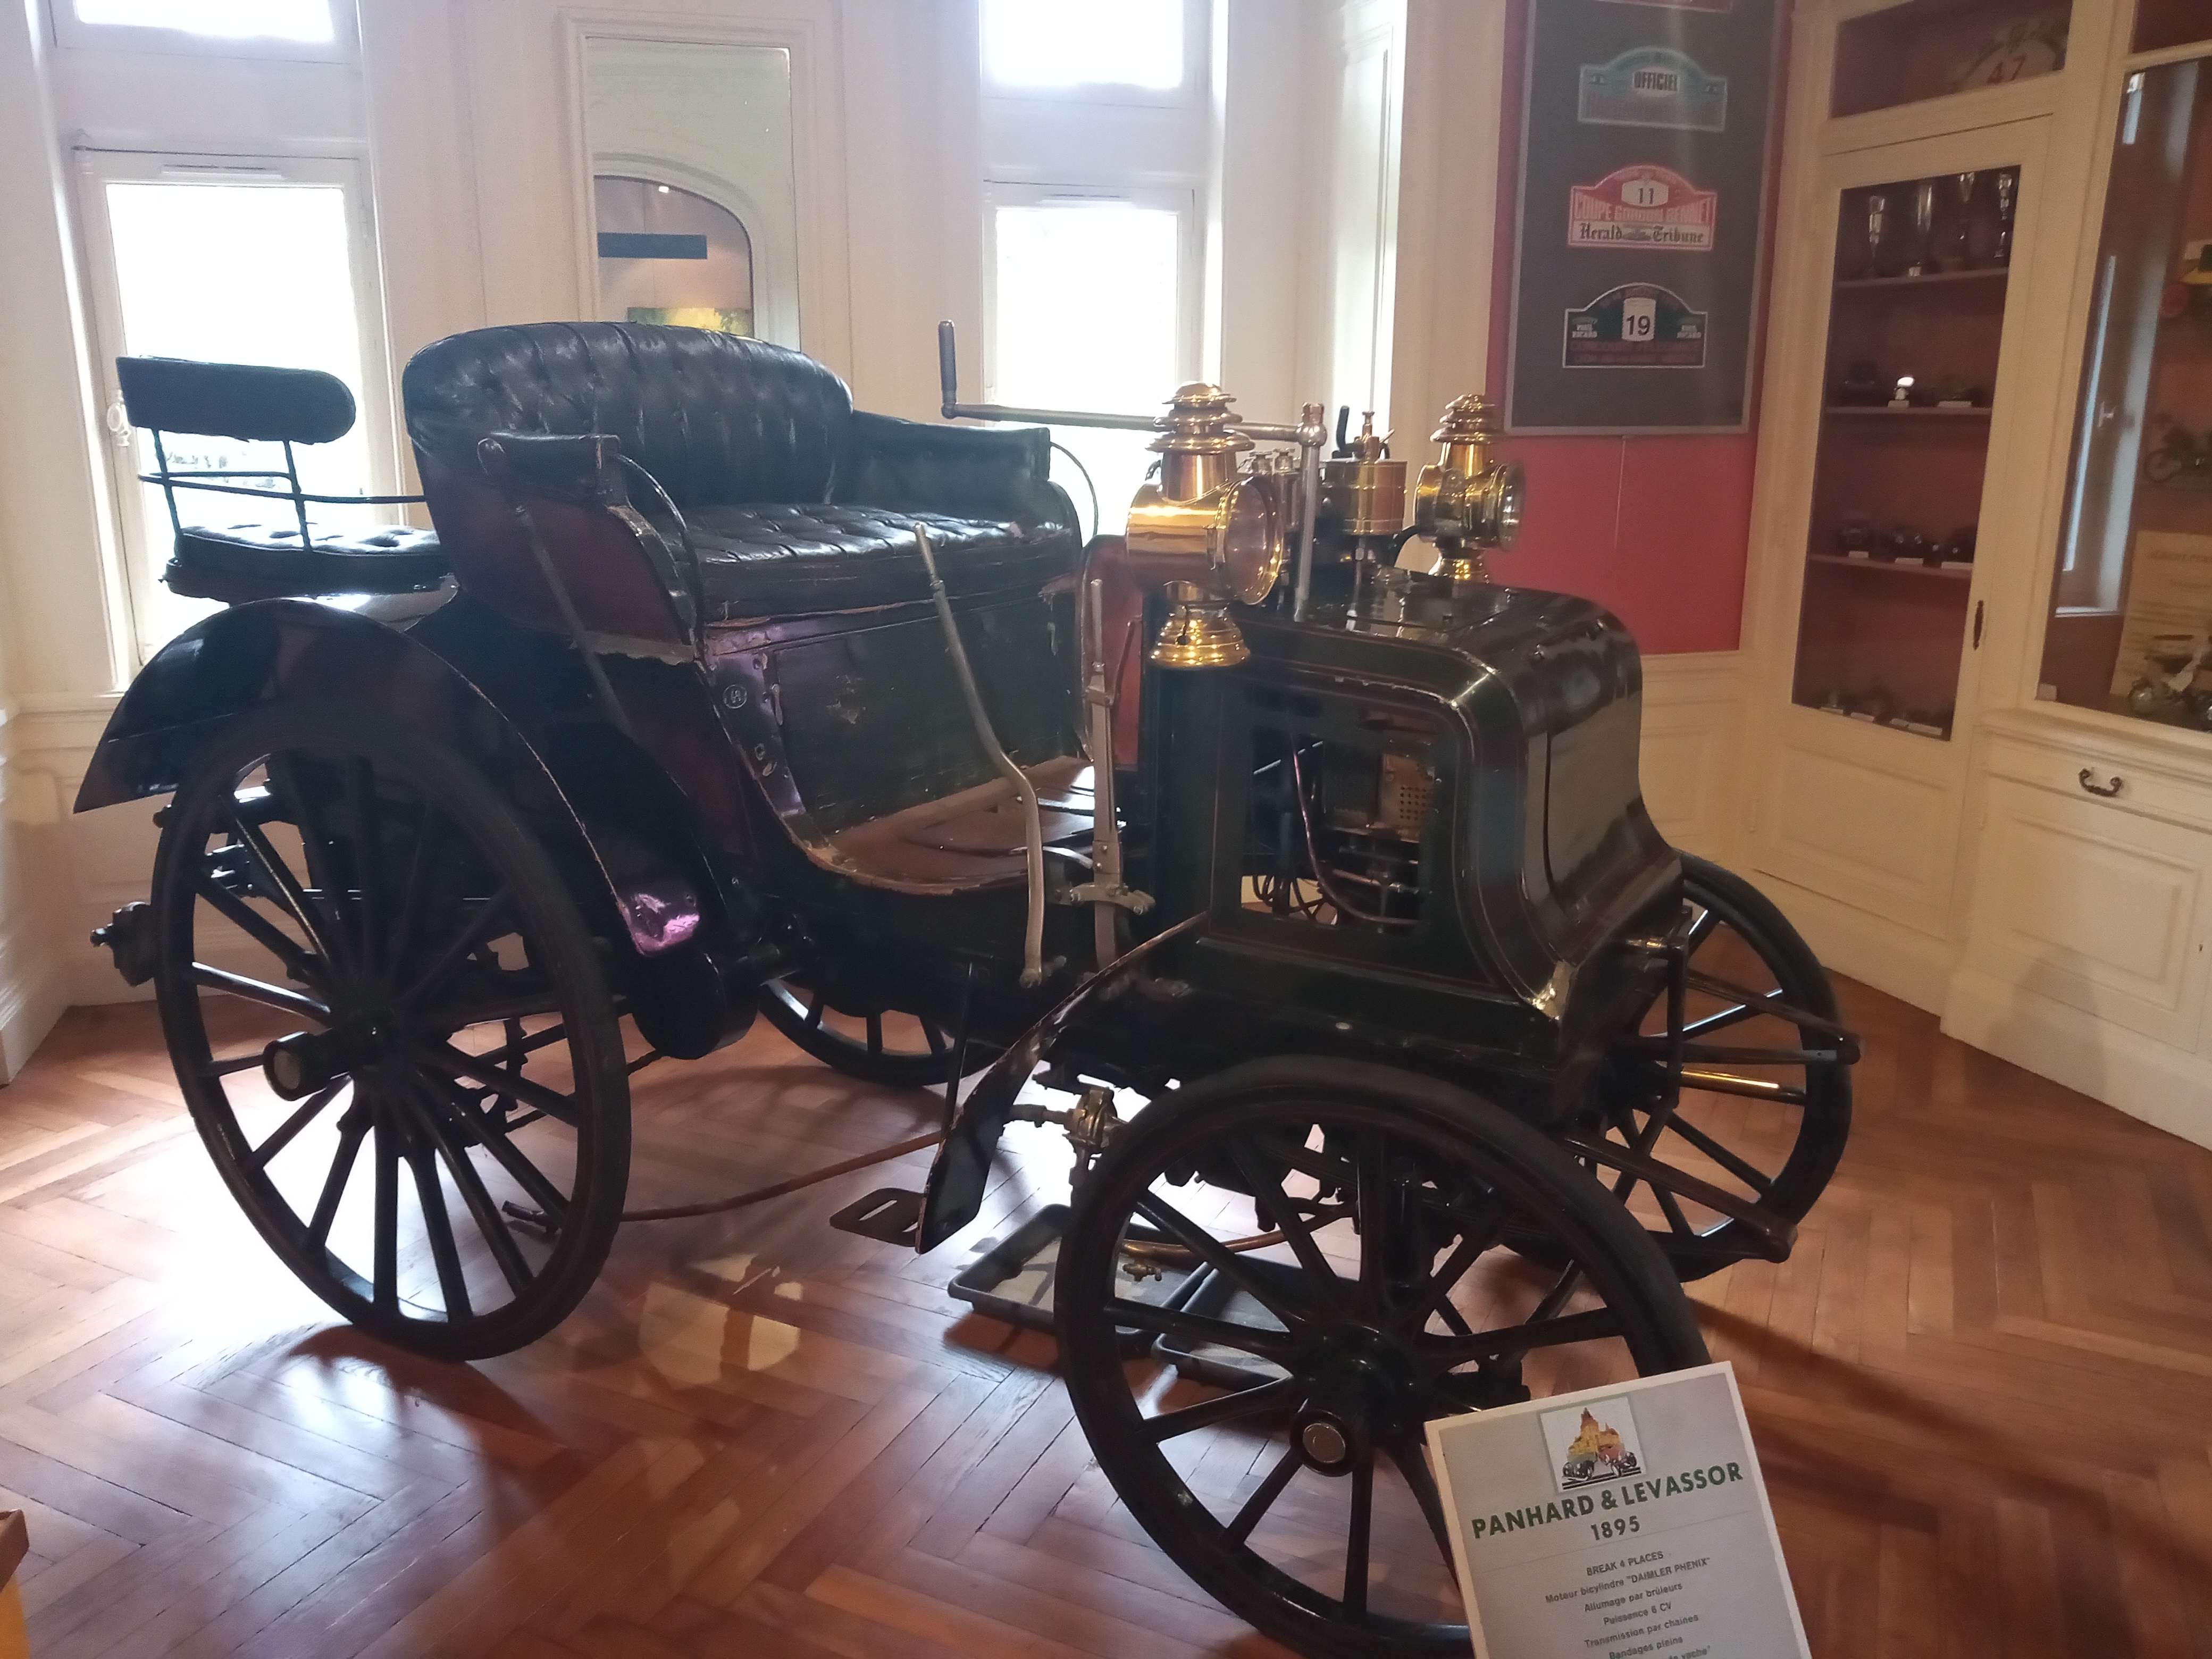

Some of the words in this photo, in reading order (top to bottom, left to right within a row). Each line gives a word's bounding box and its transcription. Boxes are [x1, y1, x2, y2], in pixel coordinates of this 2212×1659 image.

[1634, 71, 1678, 91] OFFICIEL
[1638, 188, 1654, 204] 11
[1580, 222, 1622, 239] Herald
[1653, 225, 1704, 243] Tribune
[1627, 315, 1650, 336] 19
[1471, 1495, 1594, 1539] PANHARD
[1601, 1489, 1618, 1511] &
[1621, 1462, 1743, 1506] LEVASSOR
[1590, 1515, 1641, 1540] 1895
[1586, 1562, 1617, 1576] BREAK
[1627, 1551, 1664, 1566] PLACES
[1545, 1590, 1578, 1604] Moteur
[1580, 1579, 1624, 1596] bicylindre
[1627, 1566, 1672, 1583] "DAIMLER
[1585, 1598, 1626, 1613] Allumage
[1629, 1593, 1644, 1604] par
[1646, 1583, 1683, 1597] brûleurs
[1603, 1609, 1649, 1626] Puissance
[1660, 1602, 1672, 1612] CV
[1584, 1629, 1645, 1647] Transmission
[1647, 1624, 1661, 1635] par
[1609, 1644, 1654, 1659] Bandages
[1656, 1636, 1683, 1650] pleins
